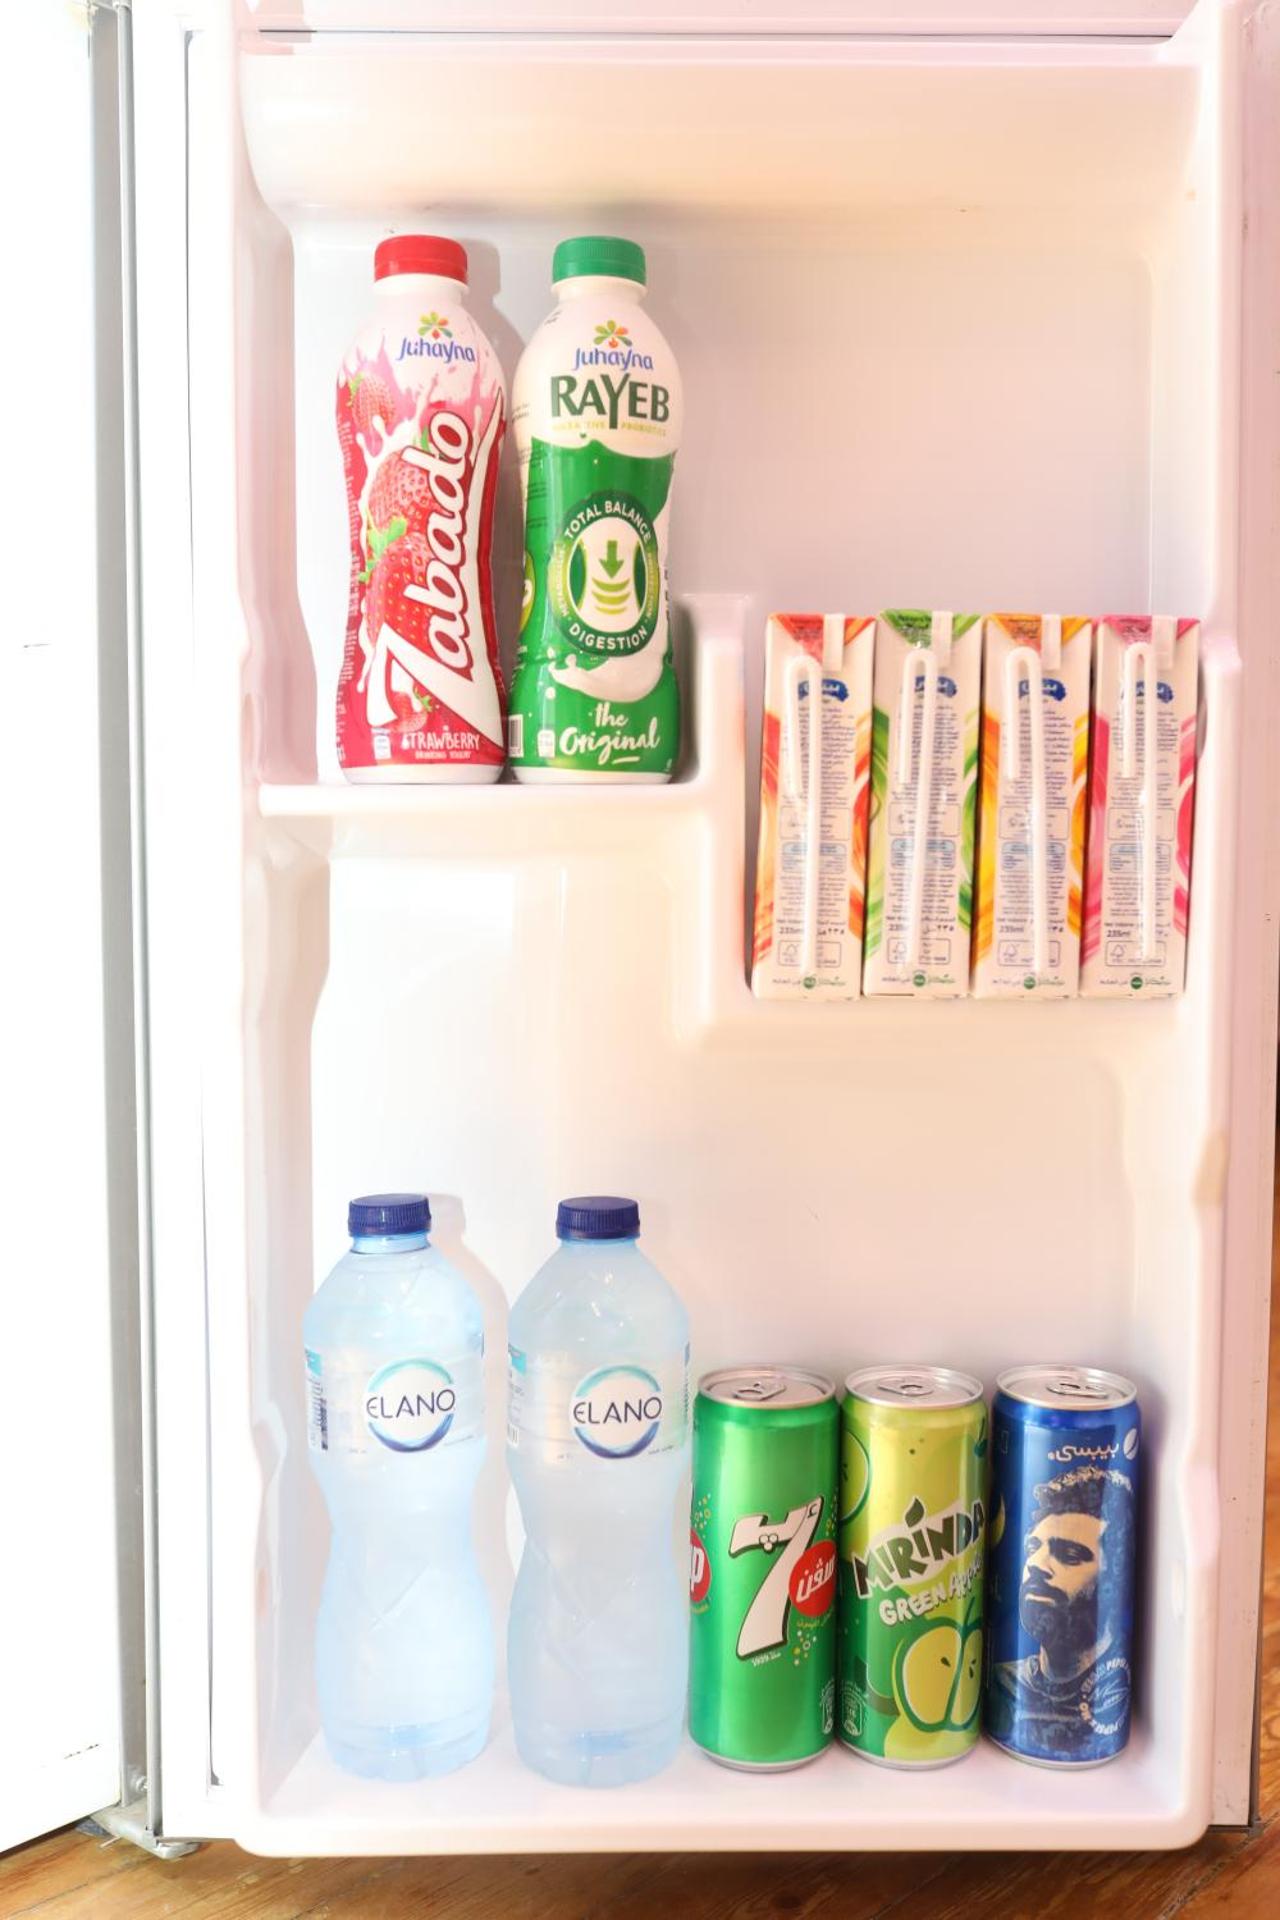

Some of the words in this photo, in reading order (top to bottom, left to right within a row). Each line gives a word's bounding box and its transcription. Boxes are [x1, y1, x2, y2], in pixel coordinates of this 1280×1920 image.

[395, 337, 477, 364] Juhayna
[573, 348, 655, 372] Juhayna
[550, 372, 670, 430] RAYEB
[565, 504, 602, 540] TOTAL
[604, 500, 652, 543] BALANCE
[366, 408, 506, 750] Zabado
[568, 622, 649, 651] DIGESTION
[594, 701, 629, 728] the
[558, 716, 661, 766] Original
[366, 1388, 456, 1420] ELANO
[573, 1396, 663, 1425] ELANO
[853, 1499, 984, 1599] MIRINDA
[728, 1496, 824, 1662] 7
[879, 1583, 949, 1626] GREEN
